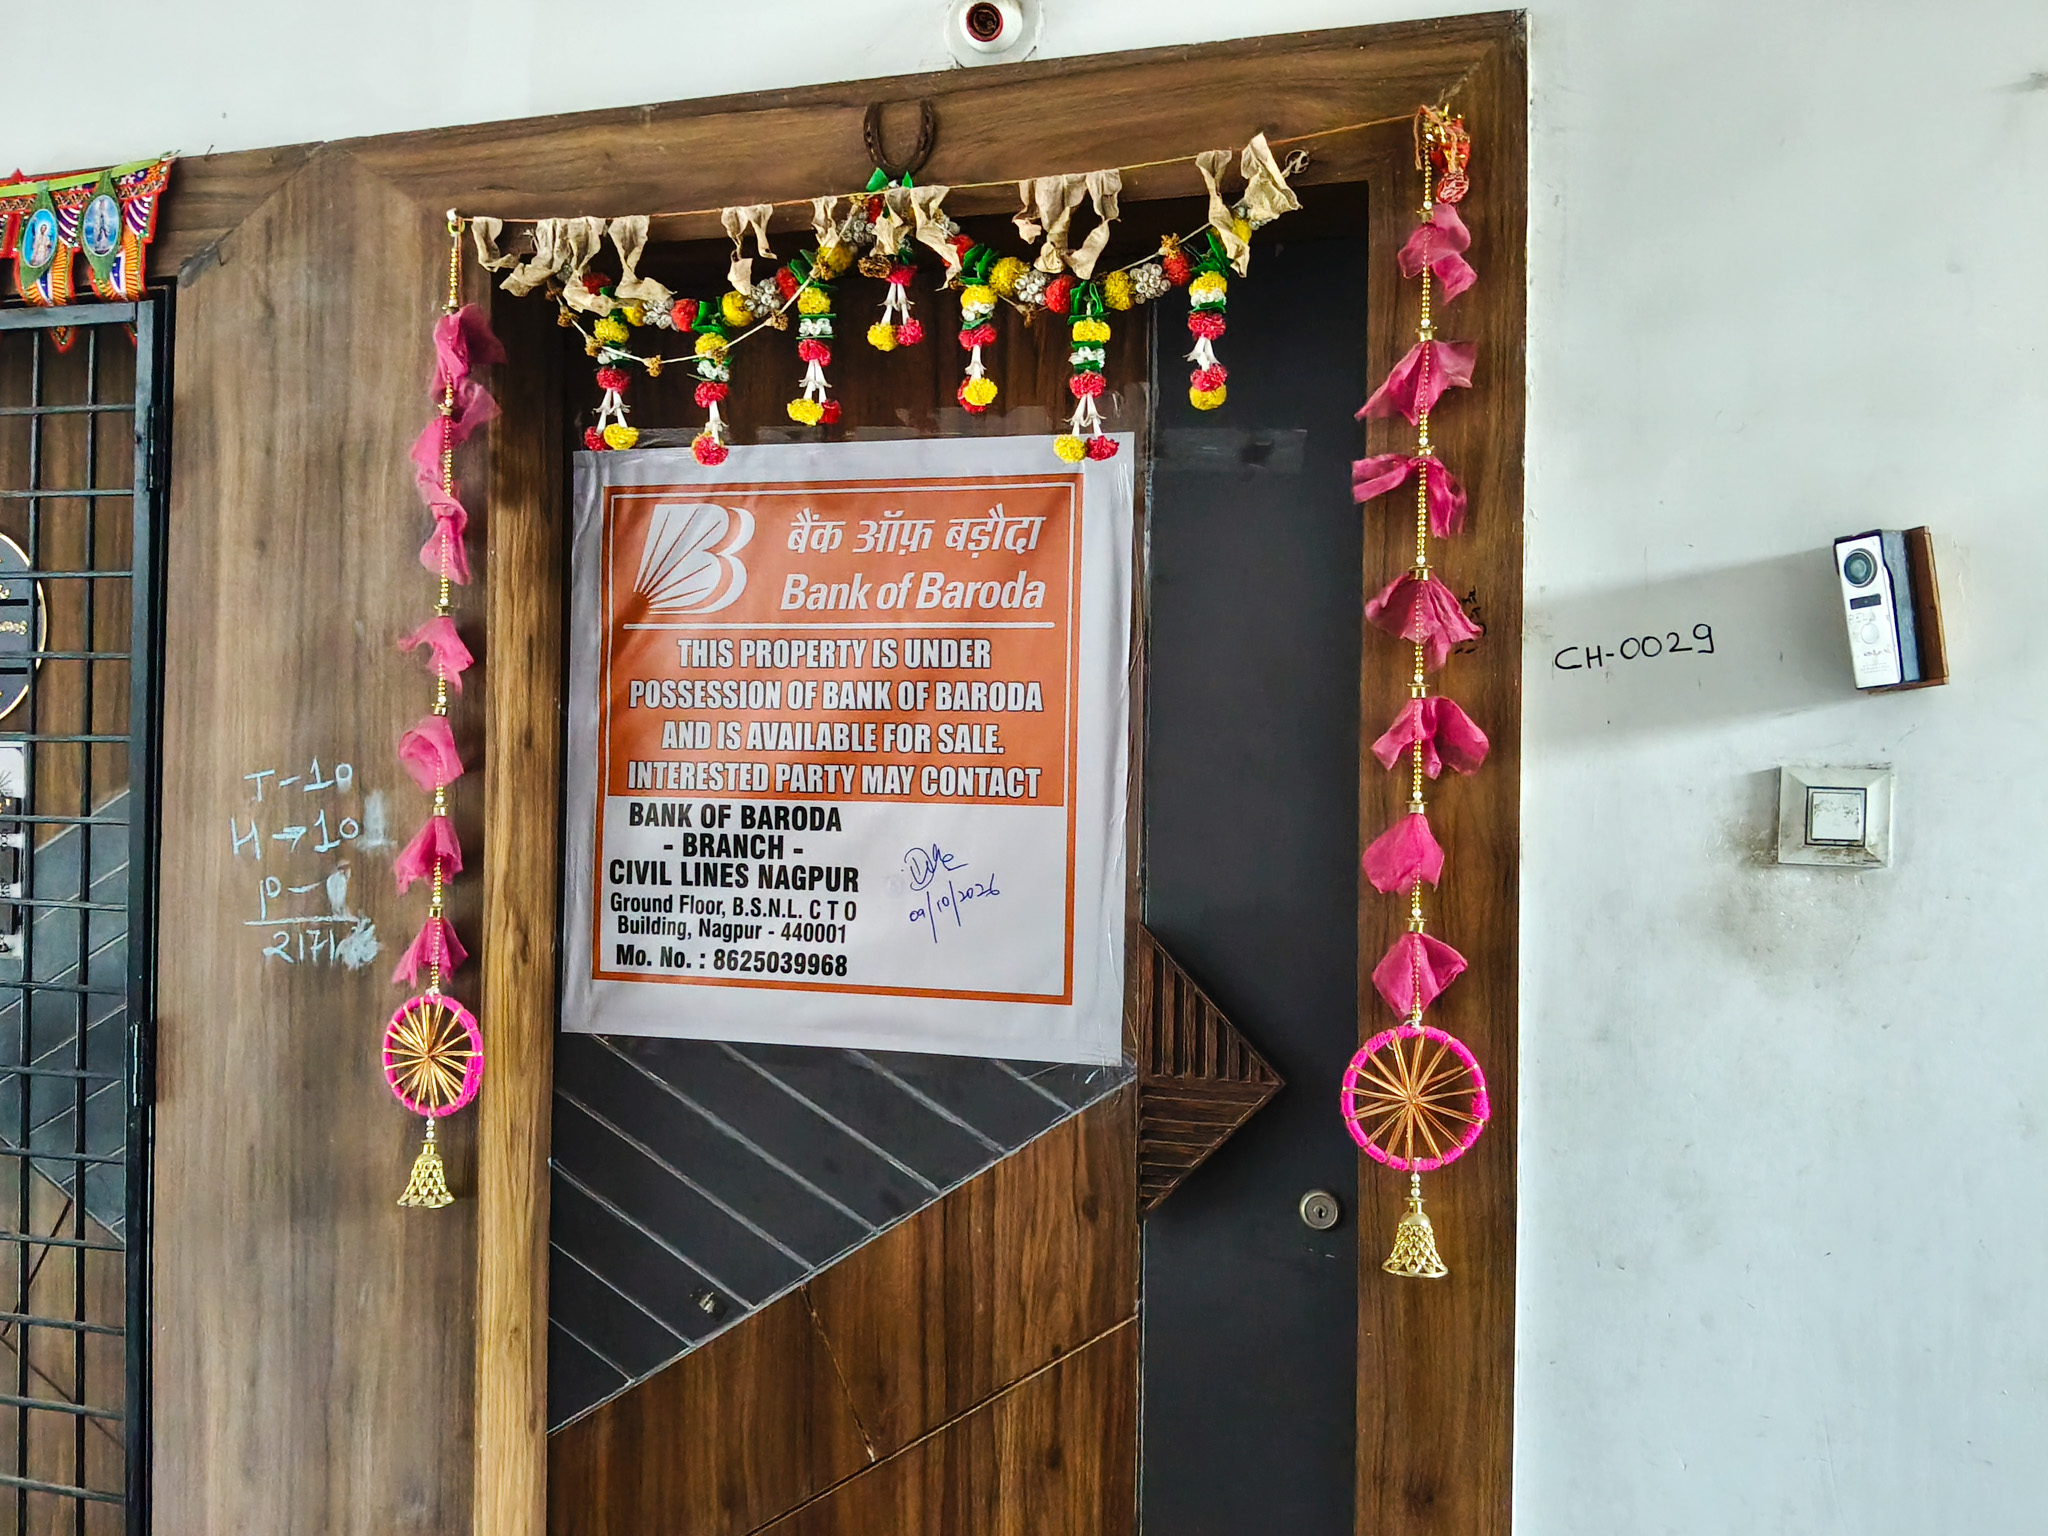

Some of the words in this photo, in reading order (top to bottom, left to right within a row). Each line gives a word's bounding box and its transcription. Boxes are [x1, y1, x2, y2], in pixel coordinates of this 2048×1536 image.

[787, 507, 846, 554] बैंक
[945, 503, 1046, 558] बड़ौदा
[780, 573, 872, 610] Bank
[876, 572, 915, 609] of
[916, 570, 1046, 609] Baroda
[677, 638, 734, 668] THIS
[740, 639, 868, 668] PROPERTY
[872, 639, 898, 668] IS
[903, 638, 991, 669] UNDER
[1553, 622, 1715, 671] CH-0029
[628, 680, 783, 710] POSSESSION
[786, 682, 818, 710] OF
[821, 682, 891, 711] BANK
[898, 682, 930, 711] OF
[935, 682, 1043, 712] BARODA
[661, 720, 710, 750] AND
[716, 722, 741, 751] IS
[746, 722, 878, 752] AVAILABLE
[883, 723, 932, 753] FOR
[937, 724, 1004, 754] SALE.
[628, 761, 770, 791] INTERESTED
[774, 763, 855, 794] PARTY
[859, 765, 915, 796] MAY
[920, 766, 1042, 798] CONTACT
[629, 802, 693, 827] BANK
[700, 804, 732, 829] OF
[741, 805, 842, 831] BARODA
[683, 833, 784, 859] BRANCH
[610, 860, 672, 885] CIVIL
[680, 862, 749, 888] LINES
[759, 865, 859, 892] NAGPUR
[611, 892, 673, 913] Ground
[680, 895, 726, 919] Floor,
[733, 897, 802, 918] B.S.N.L.
[618, 915, 692, 939] Building,
[699, 918, 762, 943] Nagpur
[781, 922, 846, 943] 440001
[616, 945, 651, 967] Mo.
[660, 946, 691, 968] No.
[713, 949, 847, 976] 8625039968
